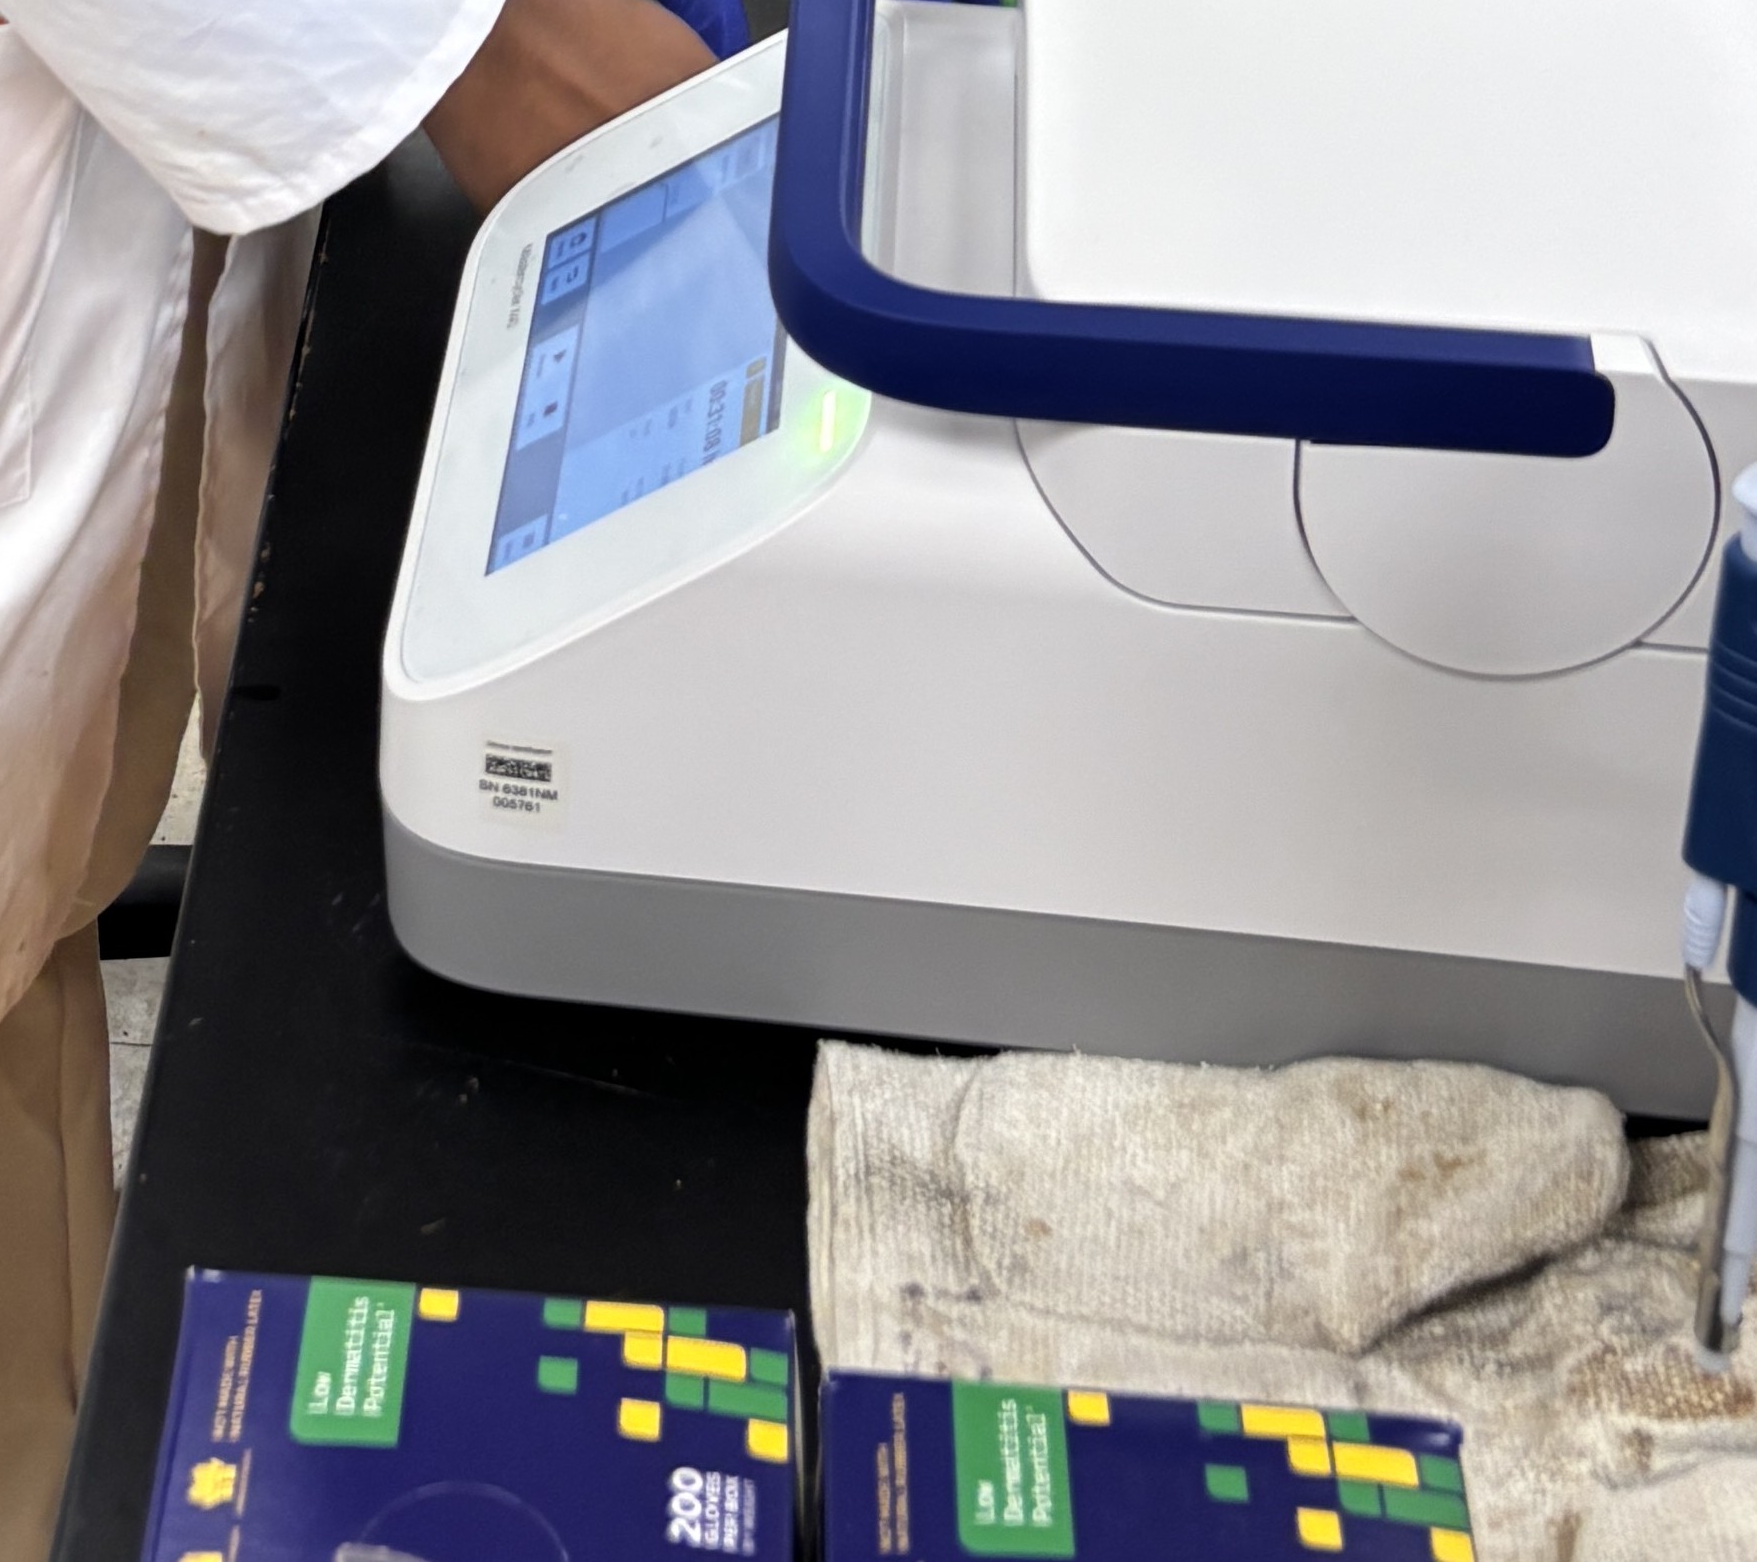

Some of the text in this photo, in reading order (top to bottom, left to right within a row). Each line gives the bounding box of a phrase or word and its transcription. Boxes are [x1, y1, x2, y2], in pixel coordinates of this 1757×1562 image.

[307, 1370, 332, 1415] Low
[334, 1296, 370, 1416] Dermatitis
[975, 1478, 996, 1526] Low
[997, 1398, 1025, 1527] Dermatitis
[667, 1465, 704, 1549] 200
[704, 1471, 721, 1550] GLOVES
